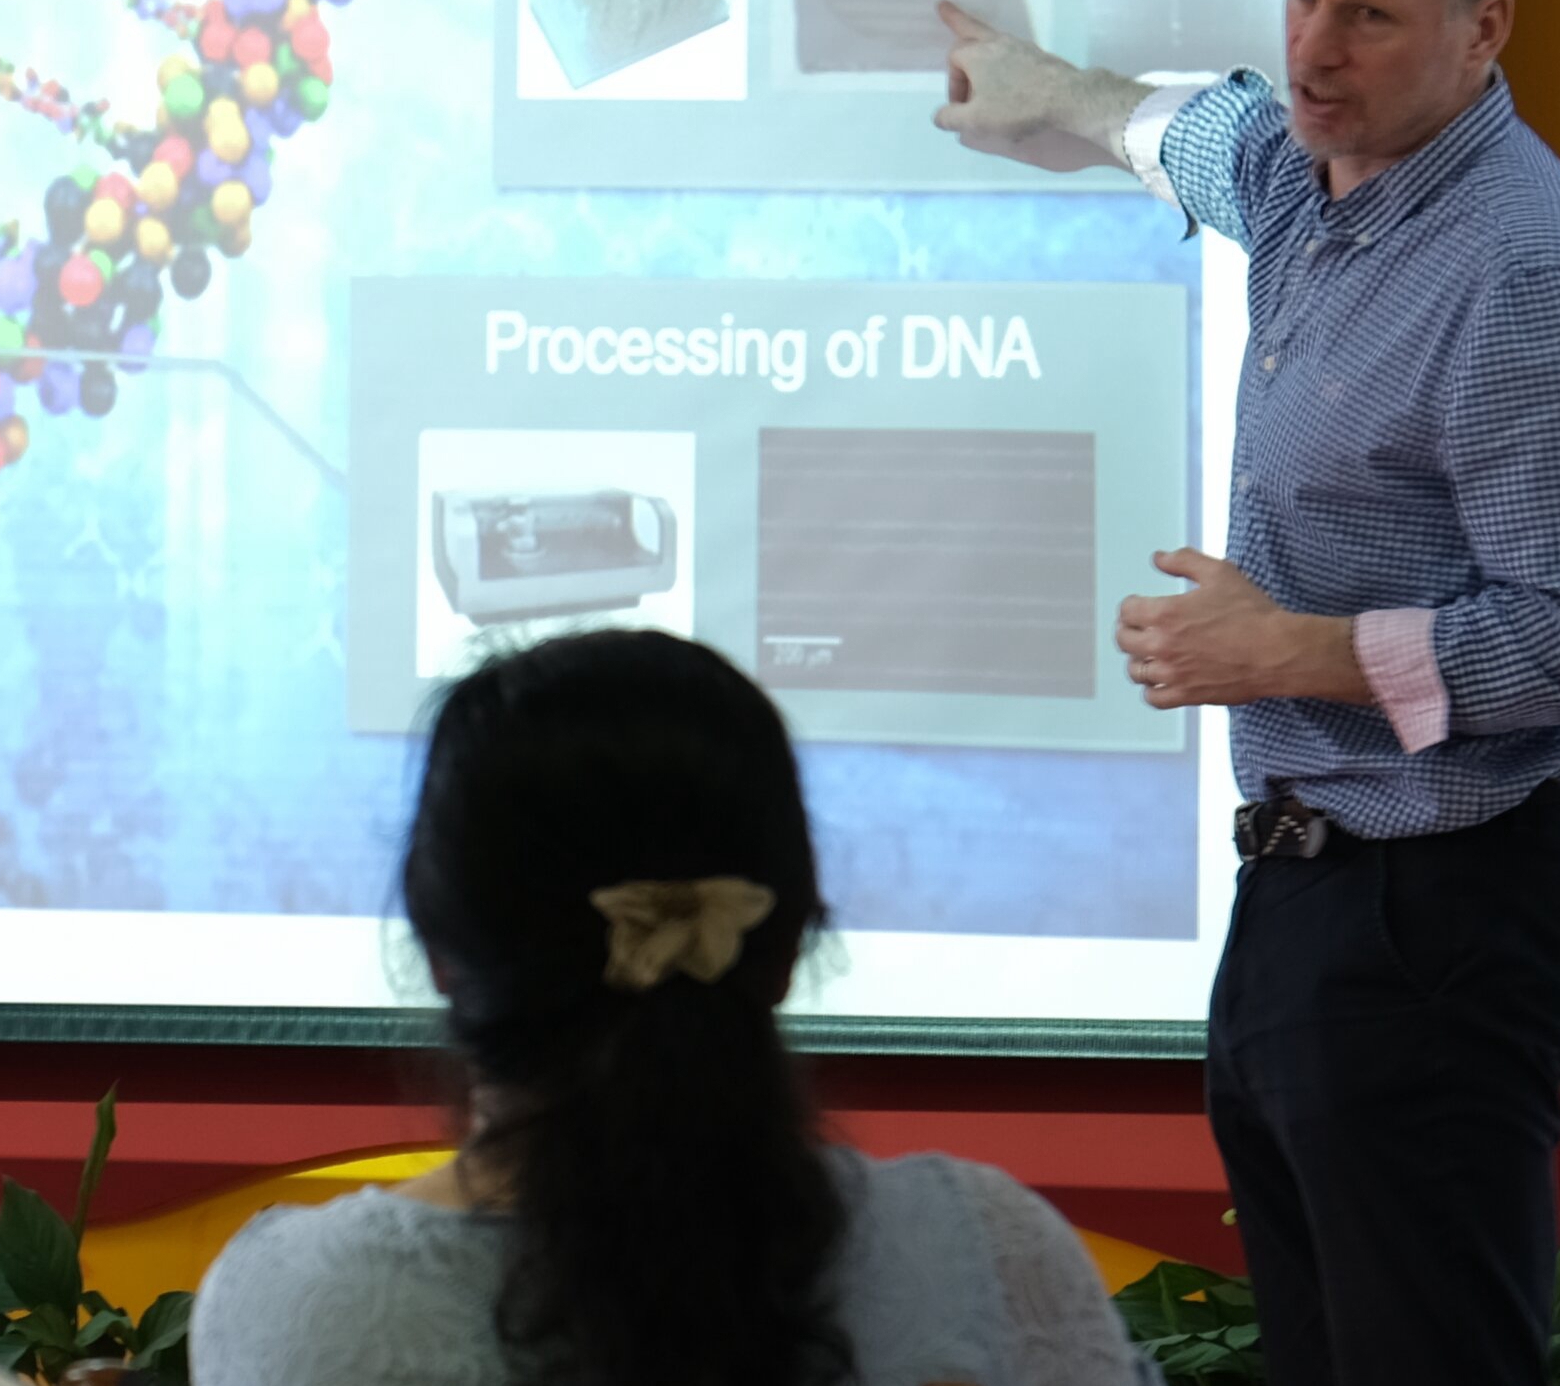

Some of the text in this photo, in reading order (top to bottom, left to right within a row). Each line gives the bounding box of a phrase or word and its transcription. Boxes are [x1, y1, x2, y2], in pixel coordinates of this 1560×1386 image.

[484, 309, 1043, 393] Processing of DNA
